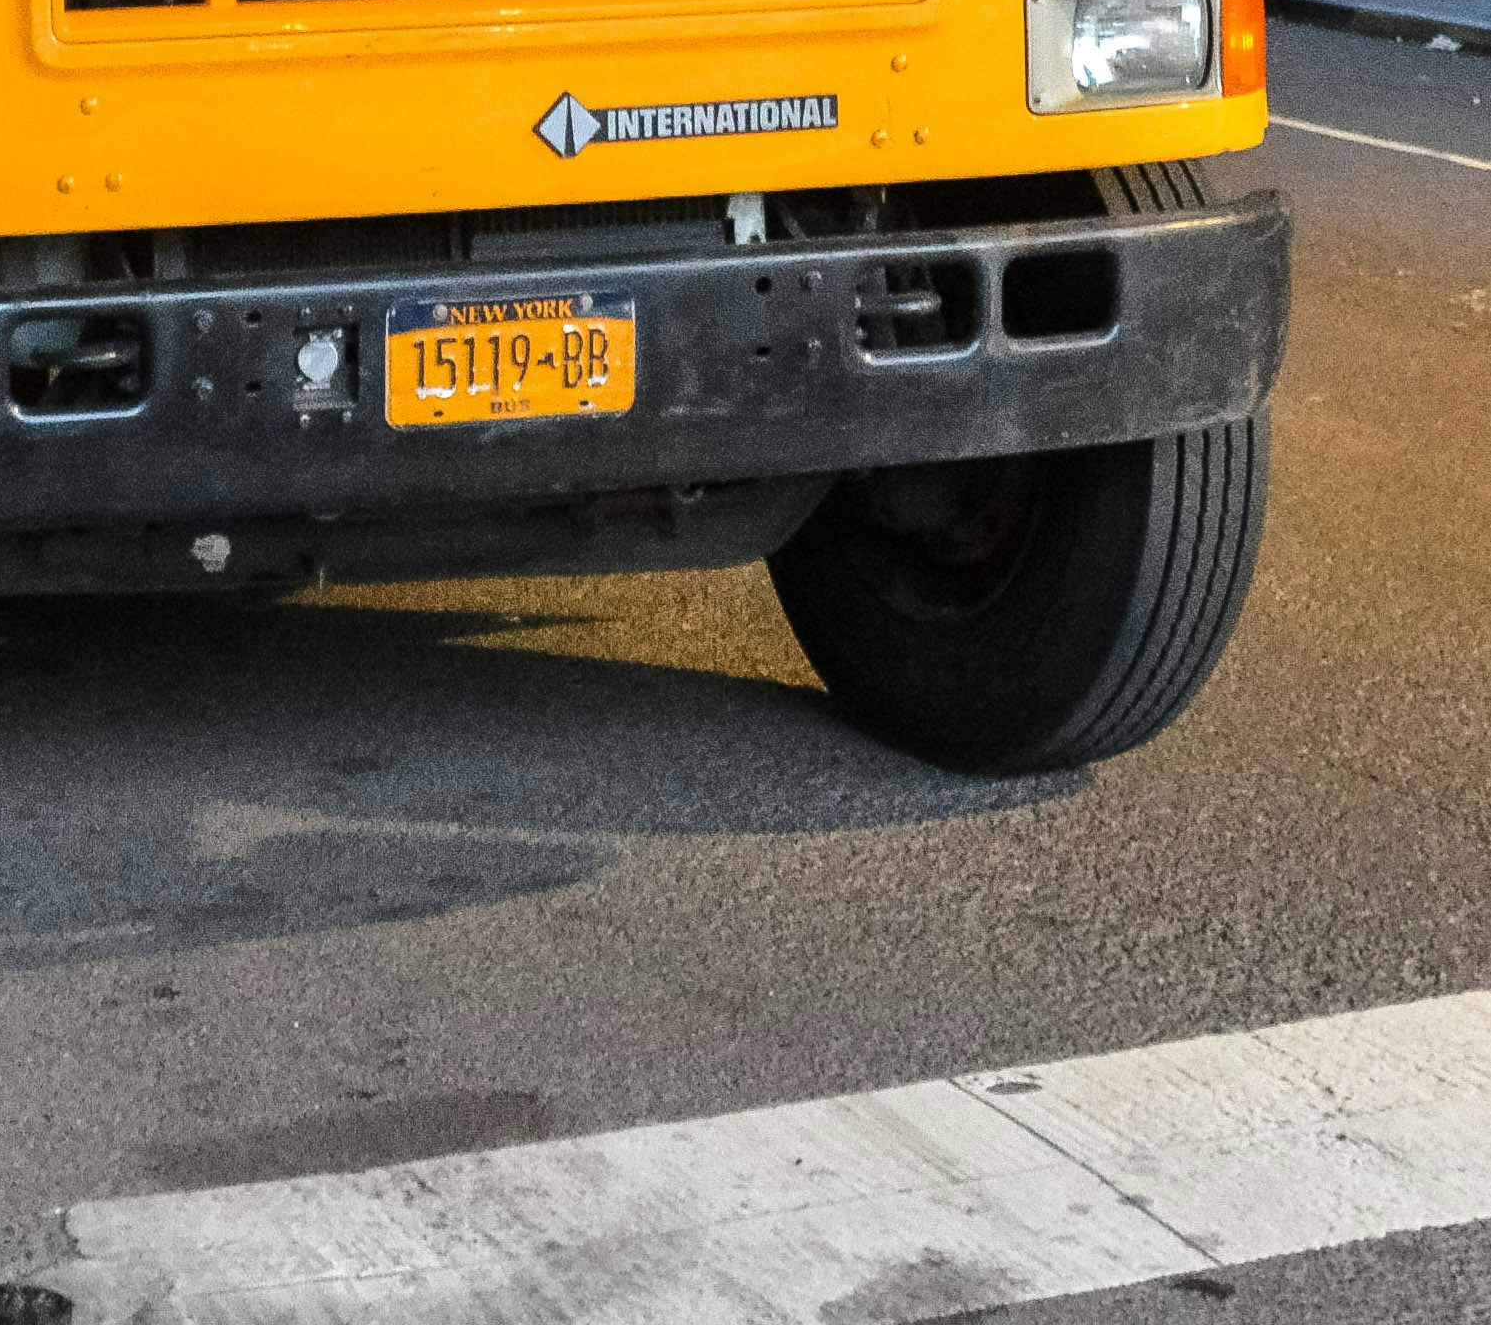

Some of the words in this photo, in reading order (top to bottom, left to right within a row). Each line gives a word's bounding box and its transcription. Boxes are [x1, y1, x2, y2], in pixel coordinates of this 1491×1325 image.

[606, 97, 838, 141] INTERNATIONAL
[450, 304, 508, 325] NEW
[514, 298, 574, 319] YORK
[490, 401, 530, 415] BUS
